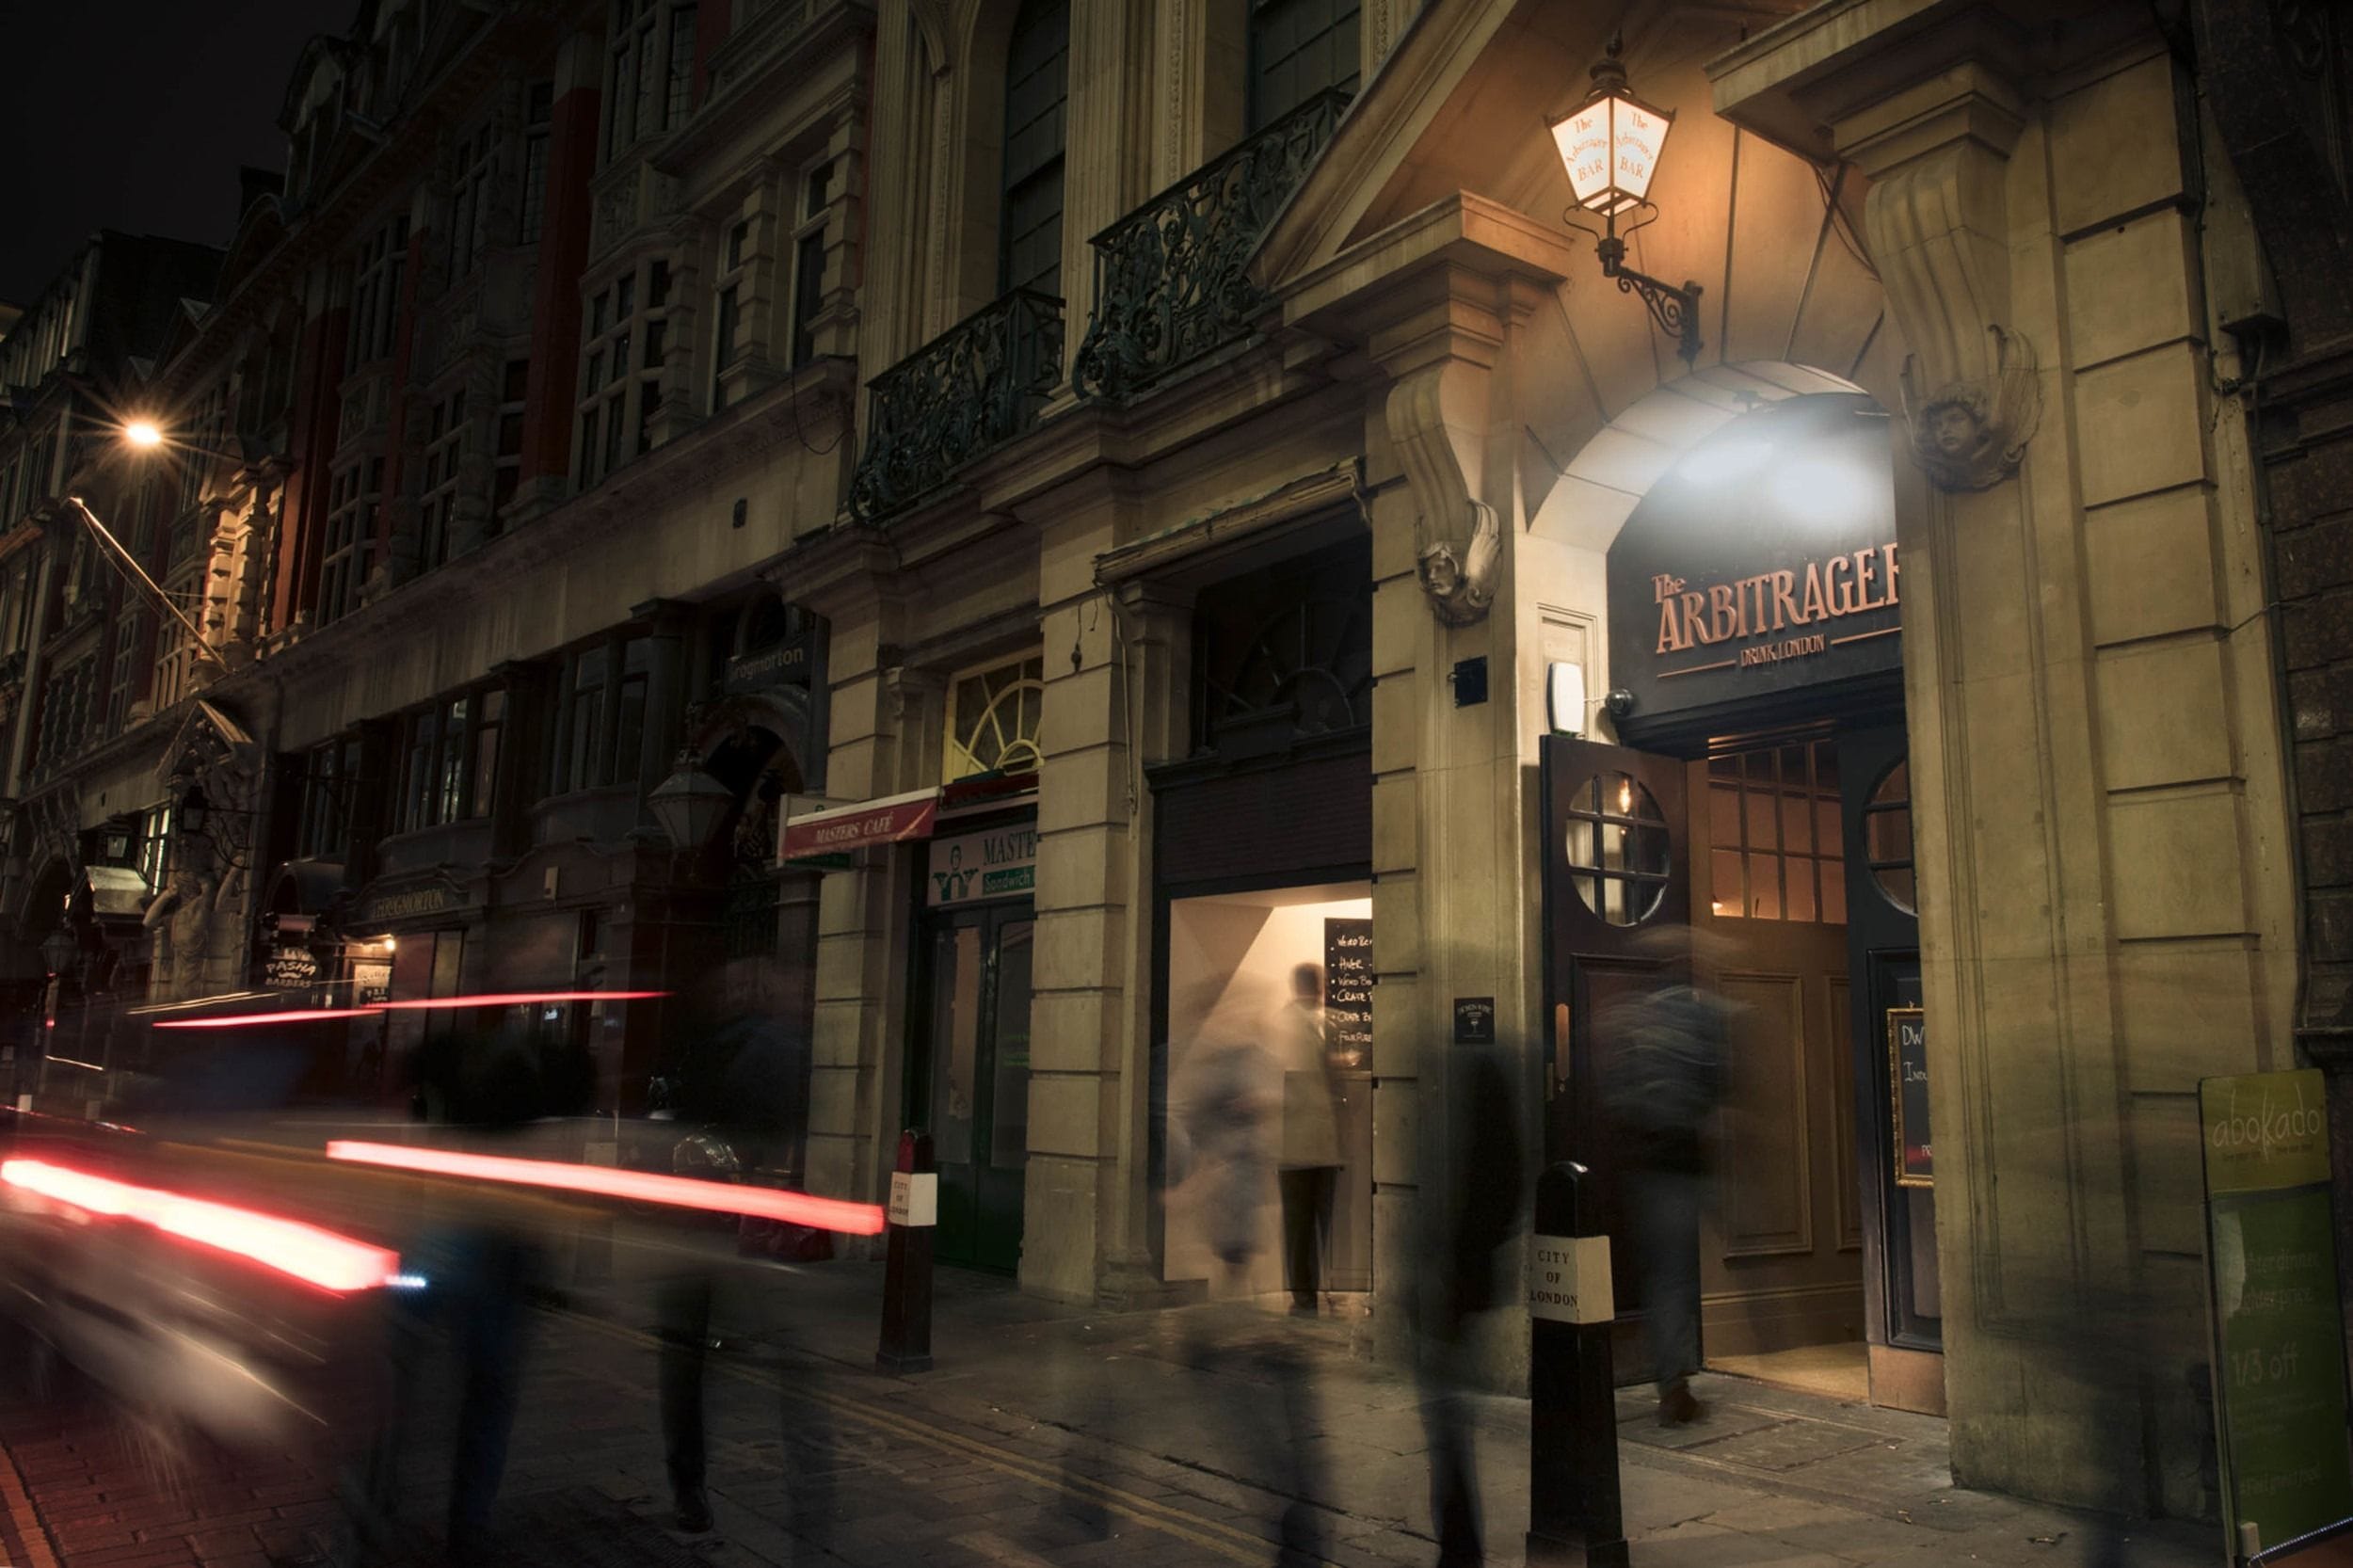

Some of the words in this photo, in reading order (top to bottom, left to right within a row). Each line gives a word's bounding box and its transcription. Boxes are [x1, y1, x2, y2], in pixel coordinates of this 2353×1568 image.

[1651, 573, 1687, 603] The
[1740, 644, 1778, 666] DRINK
[1776, 633, 1826, 659] LONDON
[816, 821, 860, 844] MASTERS
[863, 811, 894, 835] CAFÉ
[984, 830, 1035, 866] MASTE
[265, 960, 316, 976] PASHA
[2213, 1081, 2320, 1163] abokado
[1537, 1250, 1570, 1264] CITY
[1545, 1272, 1561, 1284] OF
[1529, 1290, 1578, 1308] LONDON
[2268, 1340, 2298, 1381] off
